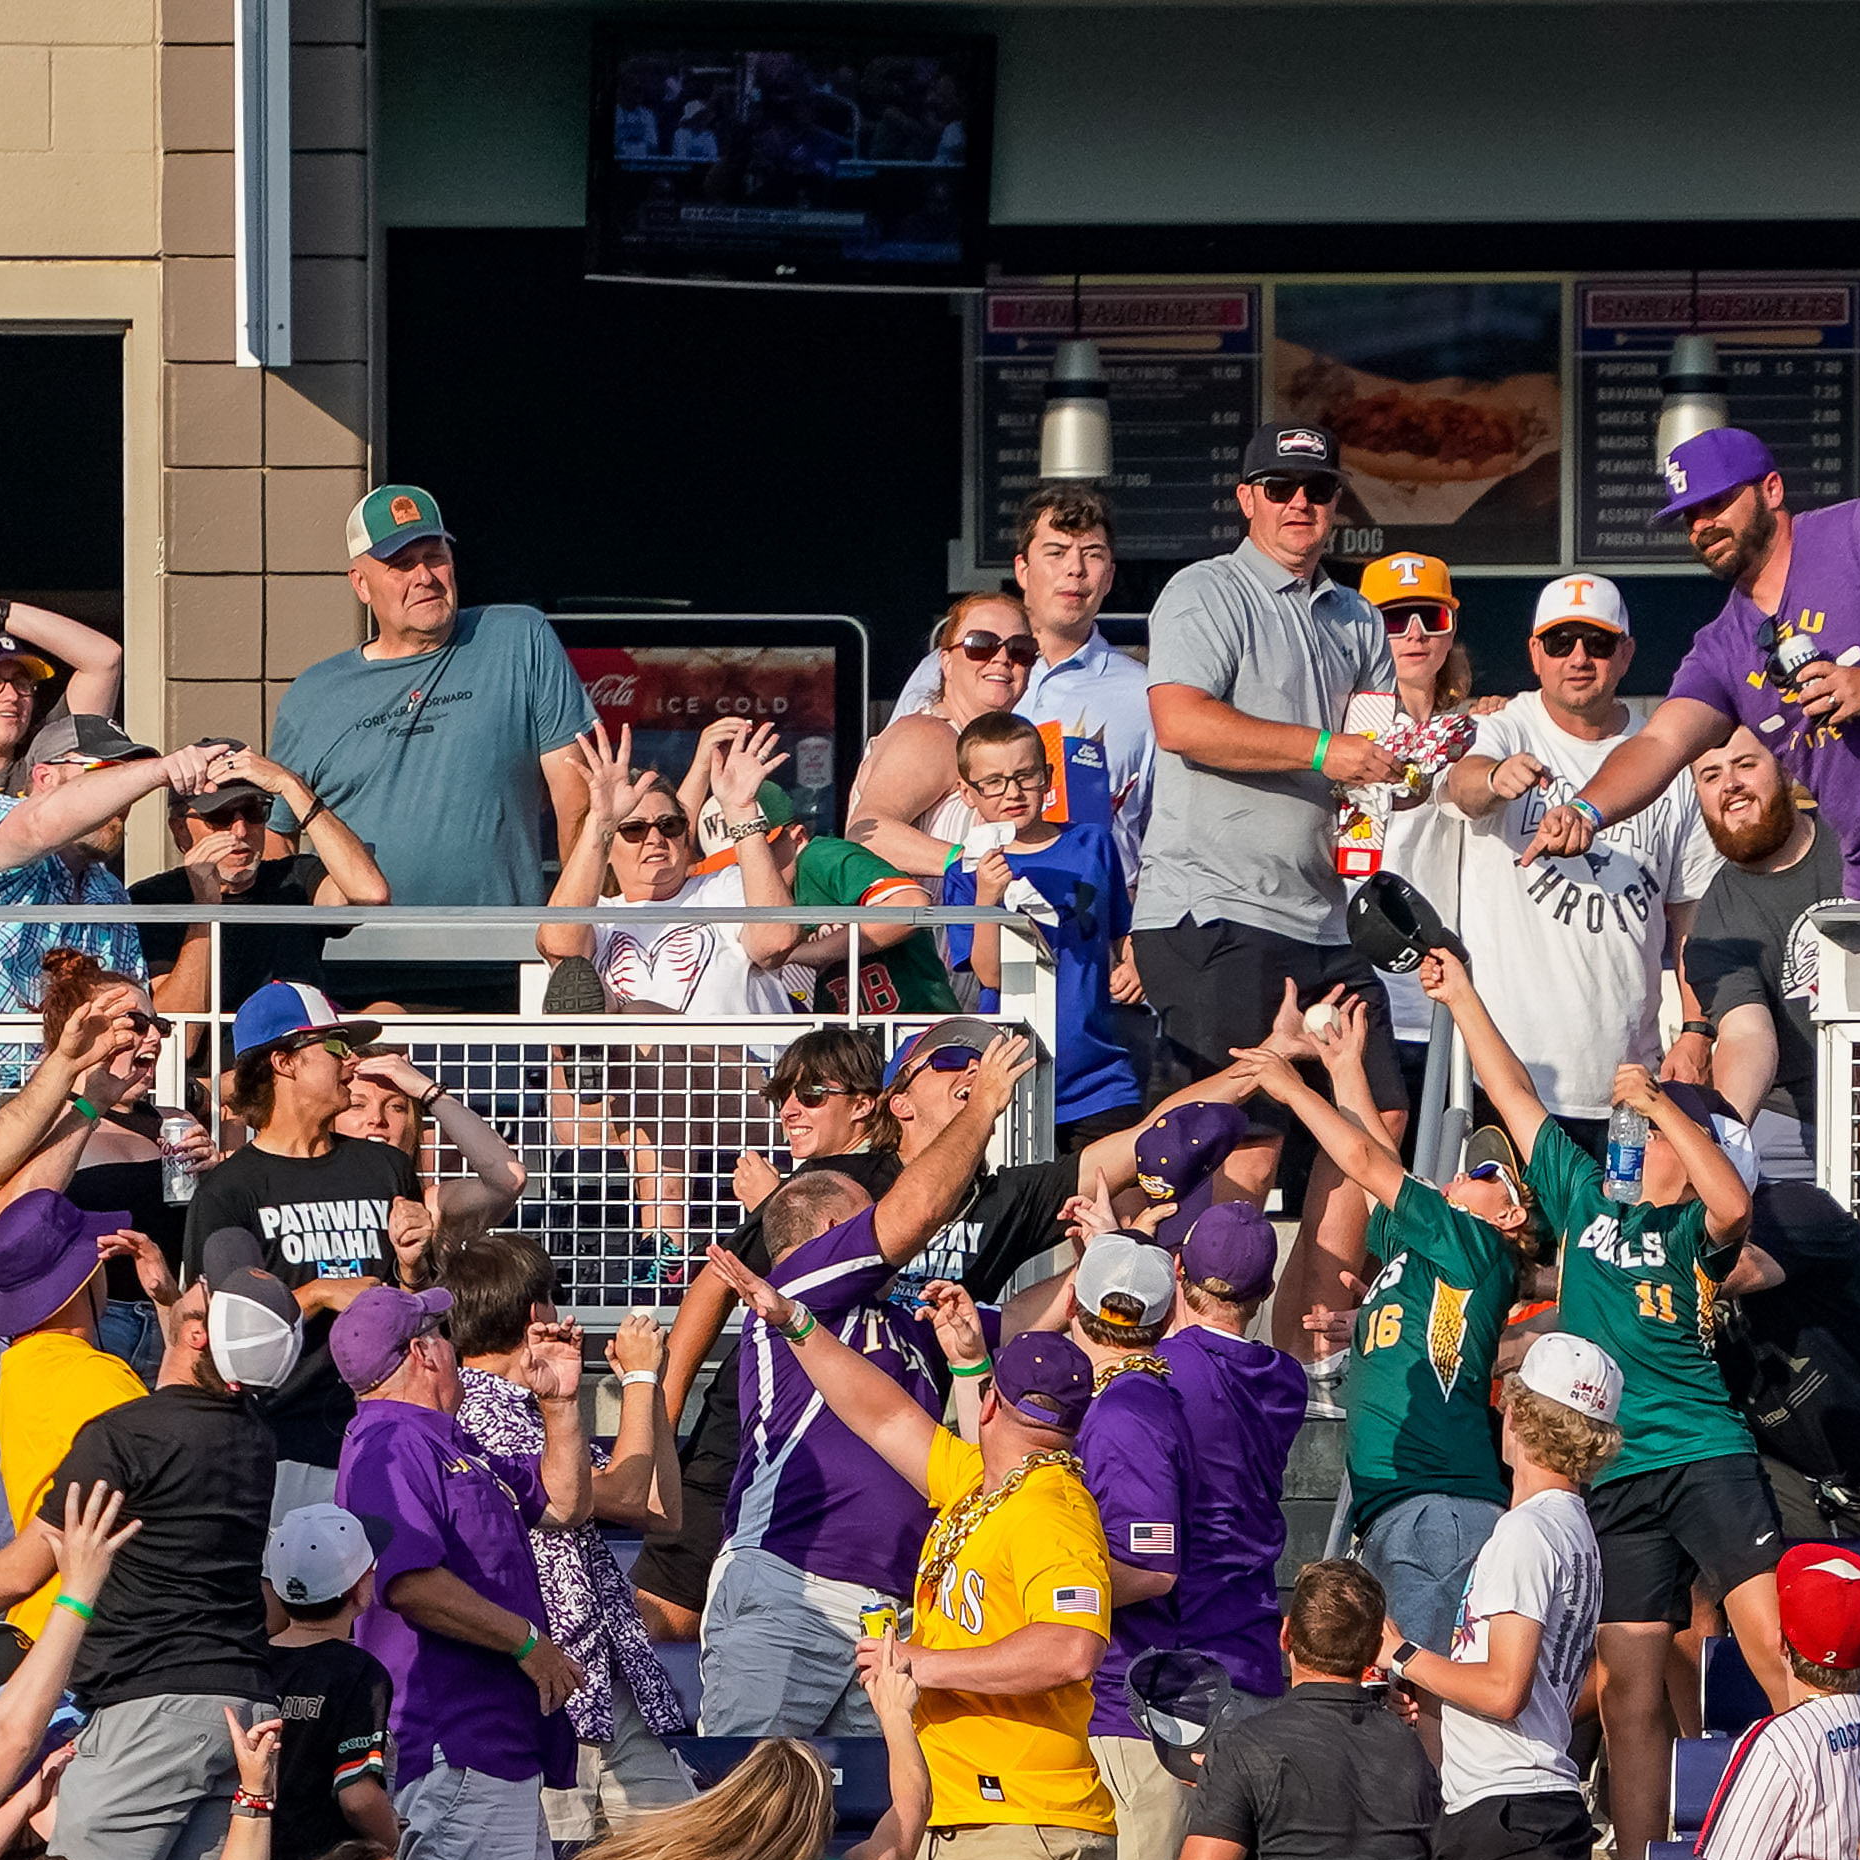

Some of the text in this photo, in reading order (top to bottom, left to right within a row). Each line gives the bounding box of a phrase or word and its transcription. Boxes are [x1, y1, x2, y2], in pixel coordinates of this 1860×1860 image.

[1344, 529, 1384, 553] DOG
[1390, 557, 1425, 585] T
[1564, 580, 1594, 606] T
[425, 690, 473, 709] ORWARD
[657, 695, 790, 714] ICE COLD
[1514, 855, 1662, 935] HROUGH
[260, 1200, 390, 1238] PATHWAY
[280, 1230, 382, 1264] OMAHA
[1578, 1212, 1667, 1269] BULLS
[1635, 1281, 1677, 1322] 11
[1363, 1303, 1404, 1357] 16
[1822, 1650, 1838, 1665] 2
